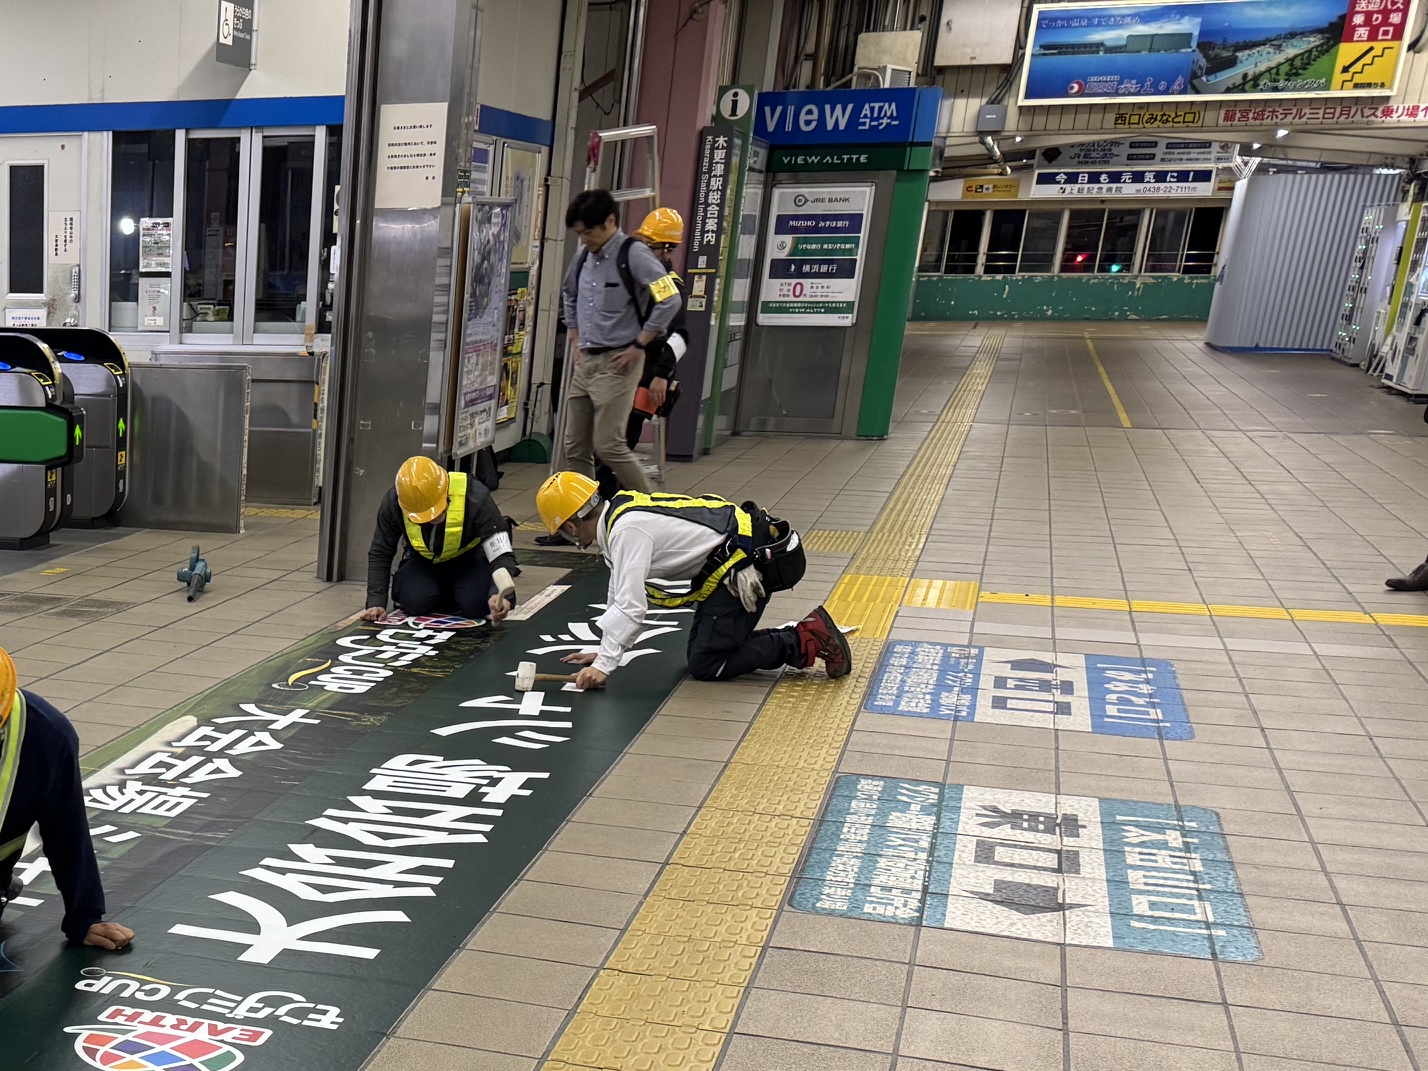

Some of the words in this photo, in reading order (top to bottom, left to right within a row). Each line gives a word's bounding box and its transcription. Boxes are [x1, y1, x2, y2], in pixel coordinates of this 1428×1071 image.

[1040, 18, 1089, 29] でっかい温泉
[1092, 17, 1141, 26] すてきな眺め
[1351, 12, 1403, 26] 乗り場
[1352, 26, 1395, 42] 西口
[859, 101, 898, 118] ATM
[857, 118, 900, 131] コーナー
[1113, 110, 1201, 126] 西口(みなと口)
[702, 135, 714, 173] Kisarazu
[782, 155, 821, 165] VIEW
[822, 154, 870, 164] ALTTE
[699, 172, 710, 200] Station
[702, 135, 729, 246] 木更津駅総合案内
[1067, 185, 1125, 196] 上総記念病院
[1141, 185, 1191, 194] 0438-22-7111
[691, 199, 706, 252] Information
[788, 220, 816, 228] MIZUHO
[818, 220, 850, 228] みずほ銀行
[802, 264, 838, 274] 横浜銀行
[991, 675, 1075, 716] 西口
[972, 804, 1086, 876] 東口
[74, 976, 345, 1030] モンダミンCUP
[105, 1006, 266, 1043] EARTH
